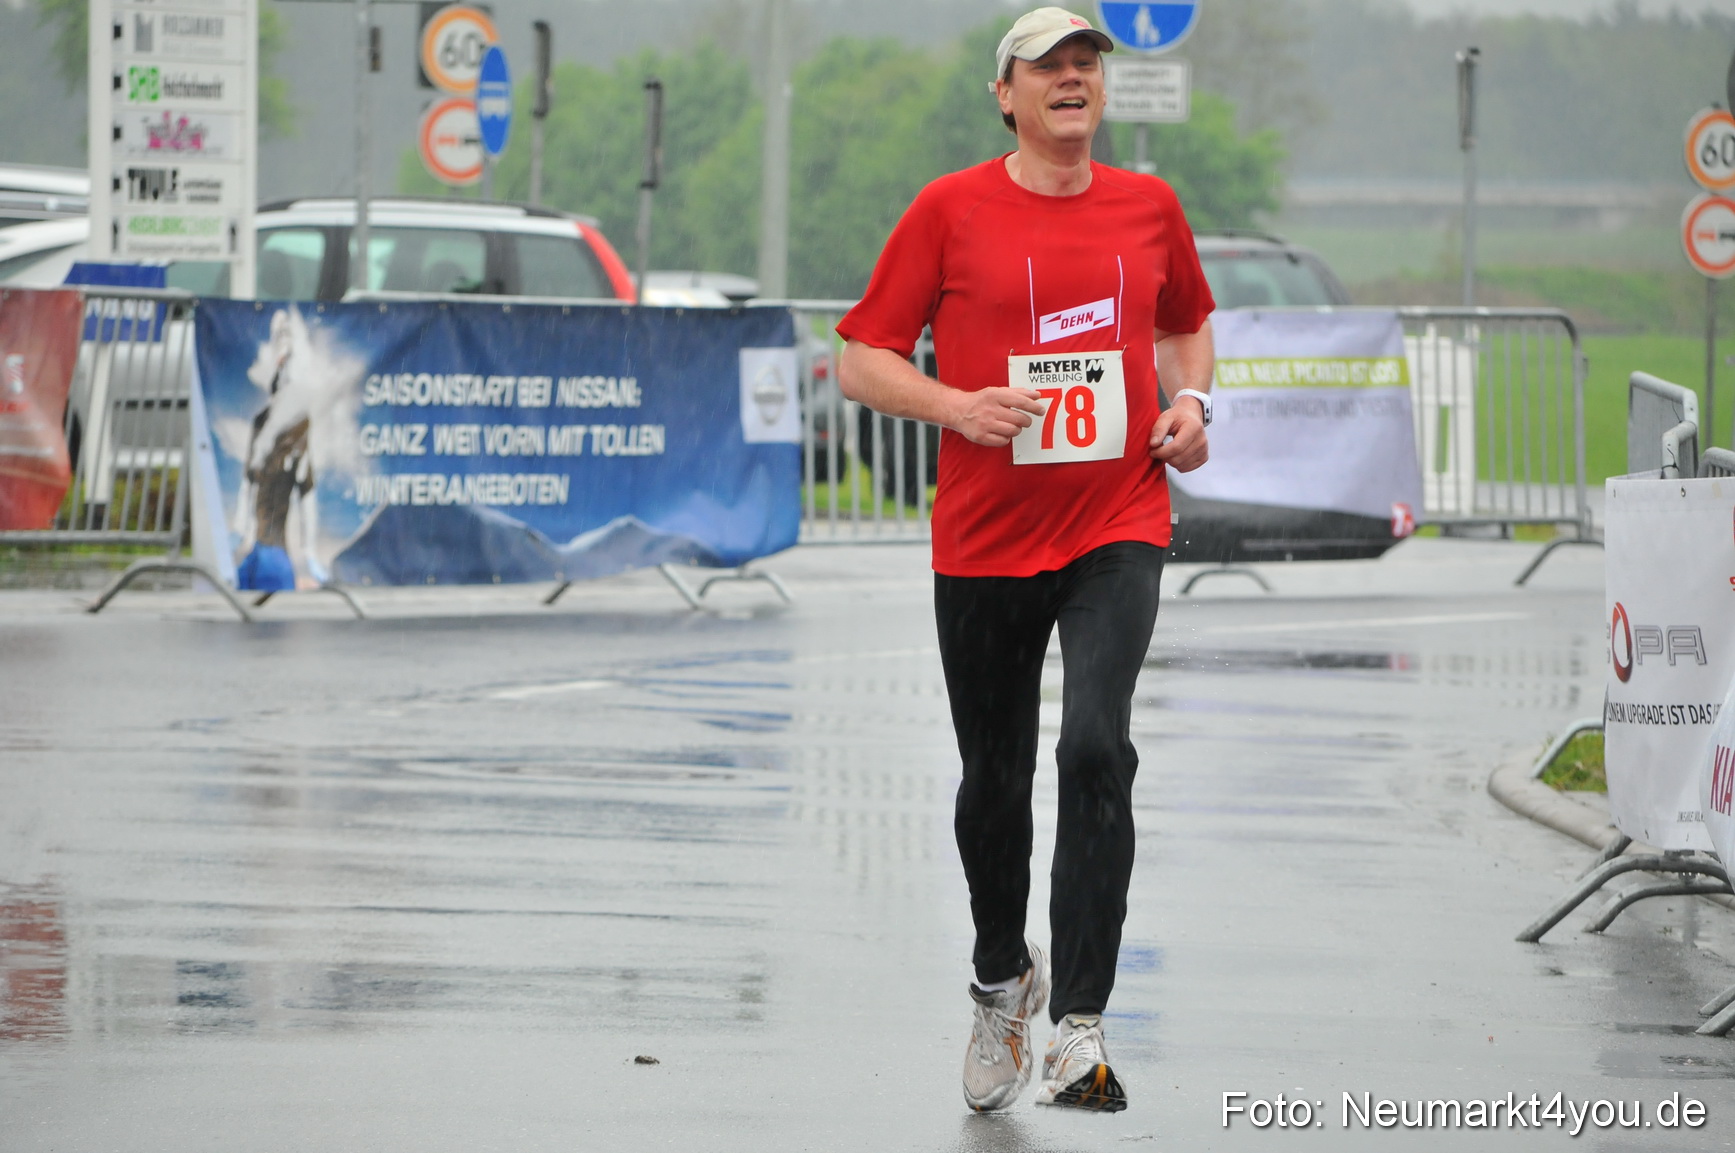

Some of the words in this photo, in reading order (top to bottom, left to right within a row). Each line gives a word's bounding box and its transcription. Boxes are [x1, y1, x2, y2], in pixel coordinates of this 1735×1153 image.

[440, 32, 481, 69] 60
[1701, 131, 1735, 168] 60
[1060, 310, 1094, 331] DEHN
[1028, 359, 1081, 374] MEYER
[1028, 372, 1083, 384] WERBUNG
[1218, 360, 1249, 386] DER
[1251, 360, 1291, 385] NEUE
[363, 372, 516, 408] SAISONSTART
[517, 376, 552, 408] BEI
[556, 375, 642, 409] NISSAN:
[1036, 386, 1097, 450] 78
[360, 423, 428, 457] GANZ
[484, 424, 545, 457] VORN
[548, 424, 588, 457] MIT
[590, 424, 665, 457] TOLLEN
[356, 473, 570, 506] WINTERANGEBOTEN
[1627, 703, 1667, 725] UPGRADE
[1667, 704, 1687, 725] IST
[1688, 703, 1712, 725] DAS
[1710, 744, 1735, 817] KIA
